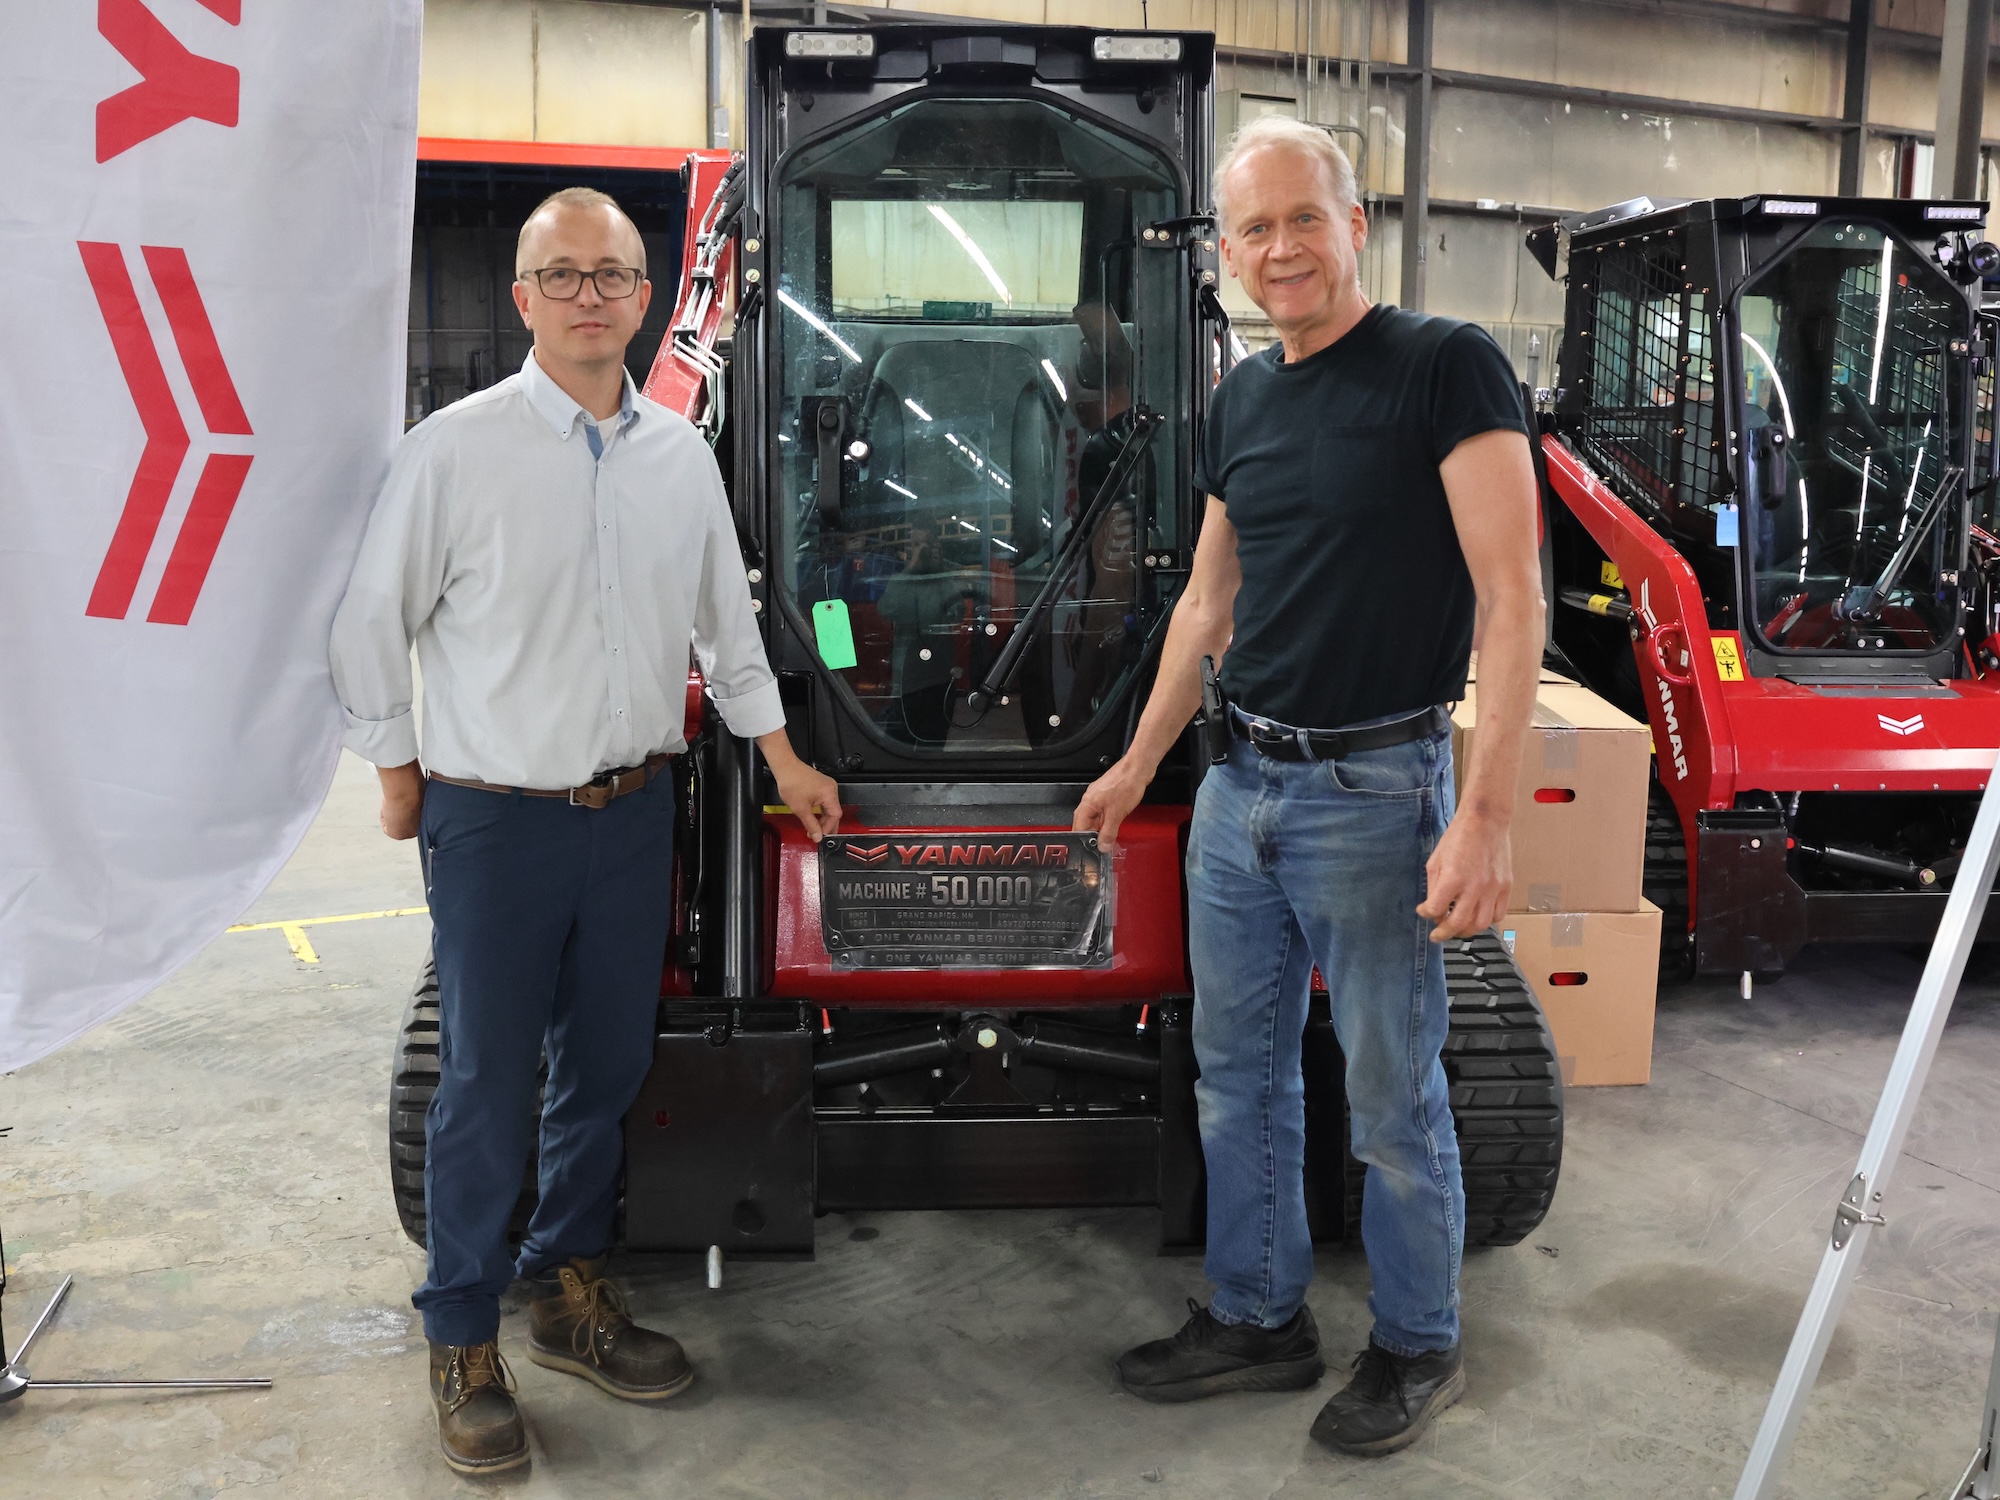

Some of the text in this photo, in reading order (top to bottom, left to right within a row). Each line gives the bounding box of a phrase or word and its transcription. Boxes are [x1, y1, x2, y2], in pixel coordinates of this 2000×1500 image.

[1656, 645, 1688, 781] NMAR
[894, 844, 1070, 866] YANMAR
[838, 875, 1032, 907] MACHINE # 50,000
[848, 911, 868, 919] SINCE
[897, 911, 925, 919] GRAND
[928, 911, 959, 920] RAPIDS,
[875, 933, 1055, 944] ONE YANMAR BEGINS HERE
[885, 953, 1064, 963] ONE YANMAR BEGINS HERE
